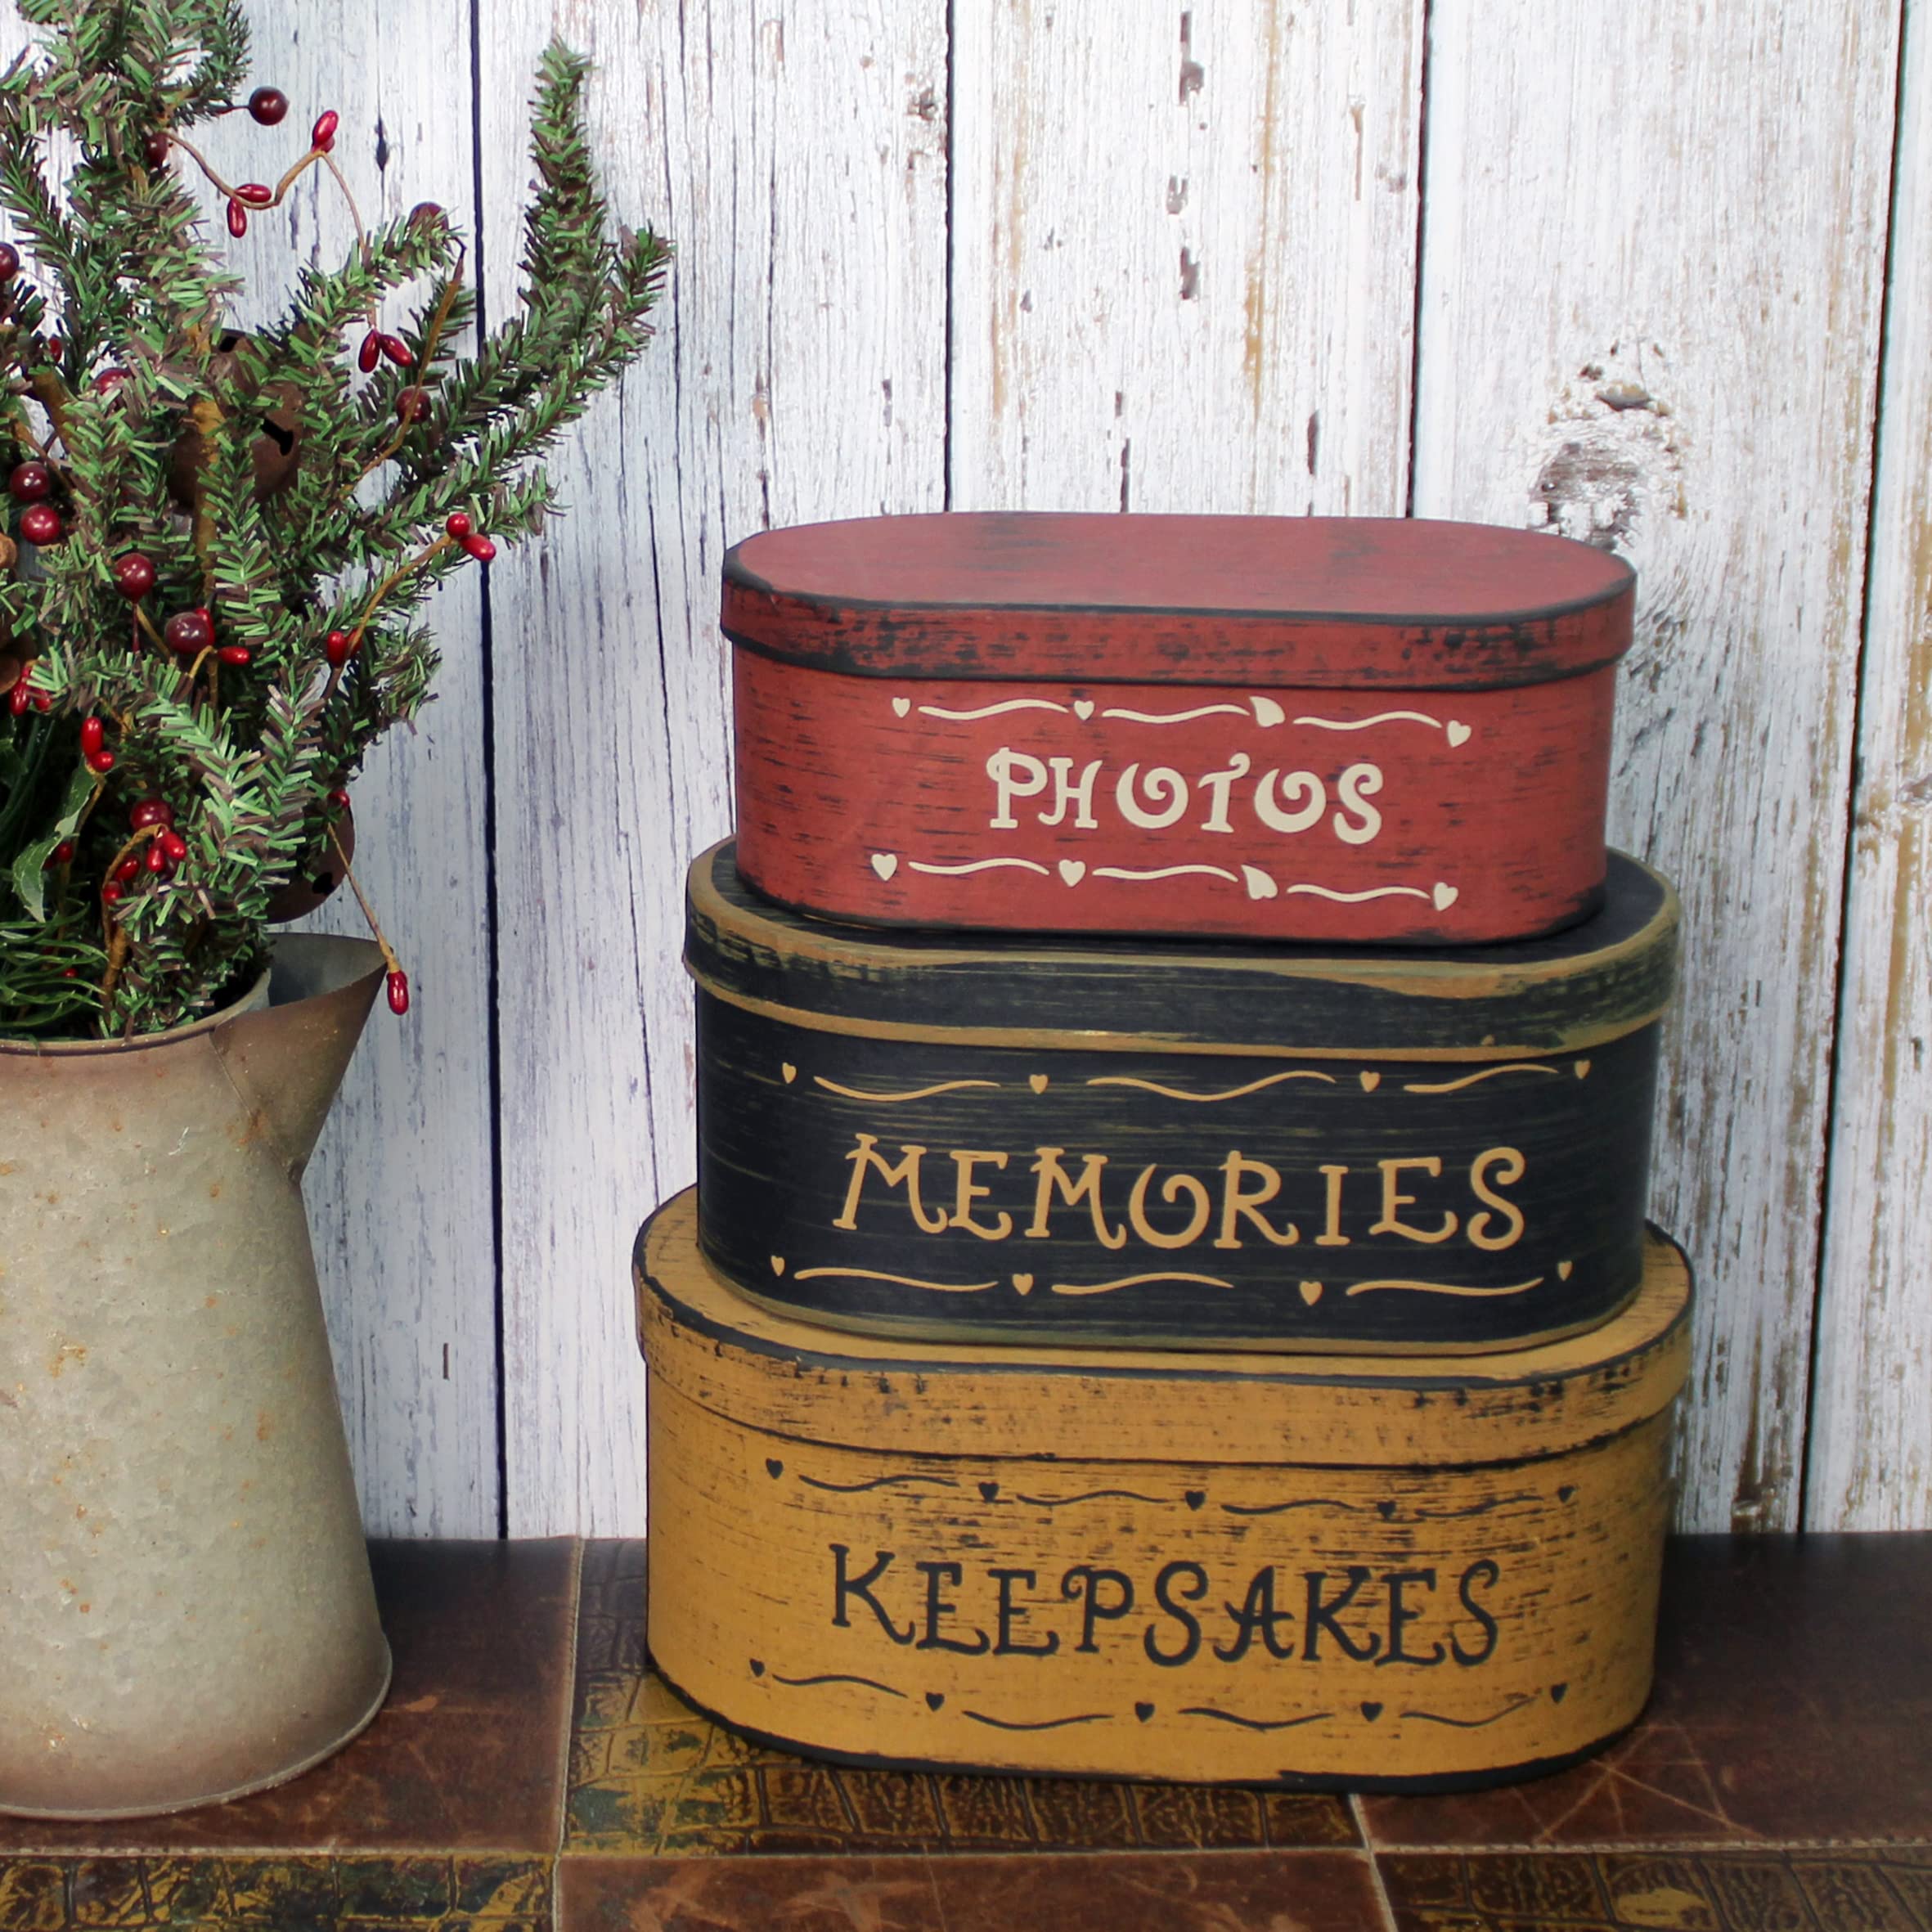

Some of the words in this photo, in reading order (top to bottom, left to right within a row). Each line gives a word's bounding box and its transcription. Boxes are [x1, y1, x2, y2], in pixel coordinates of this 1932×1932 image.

[986, 748, 1383, 844] PHOTOS
[832, 1133, 1525, 1251] MEMORIES
[829, 1543, 1500, 1667] KEEPSAKES
